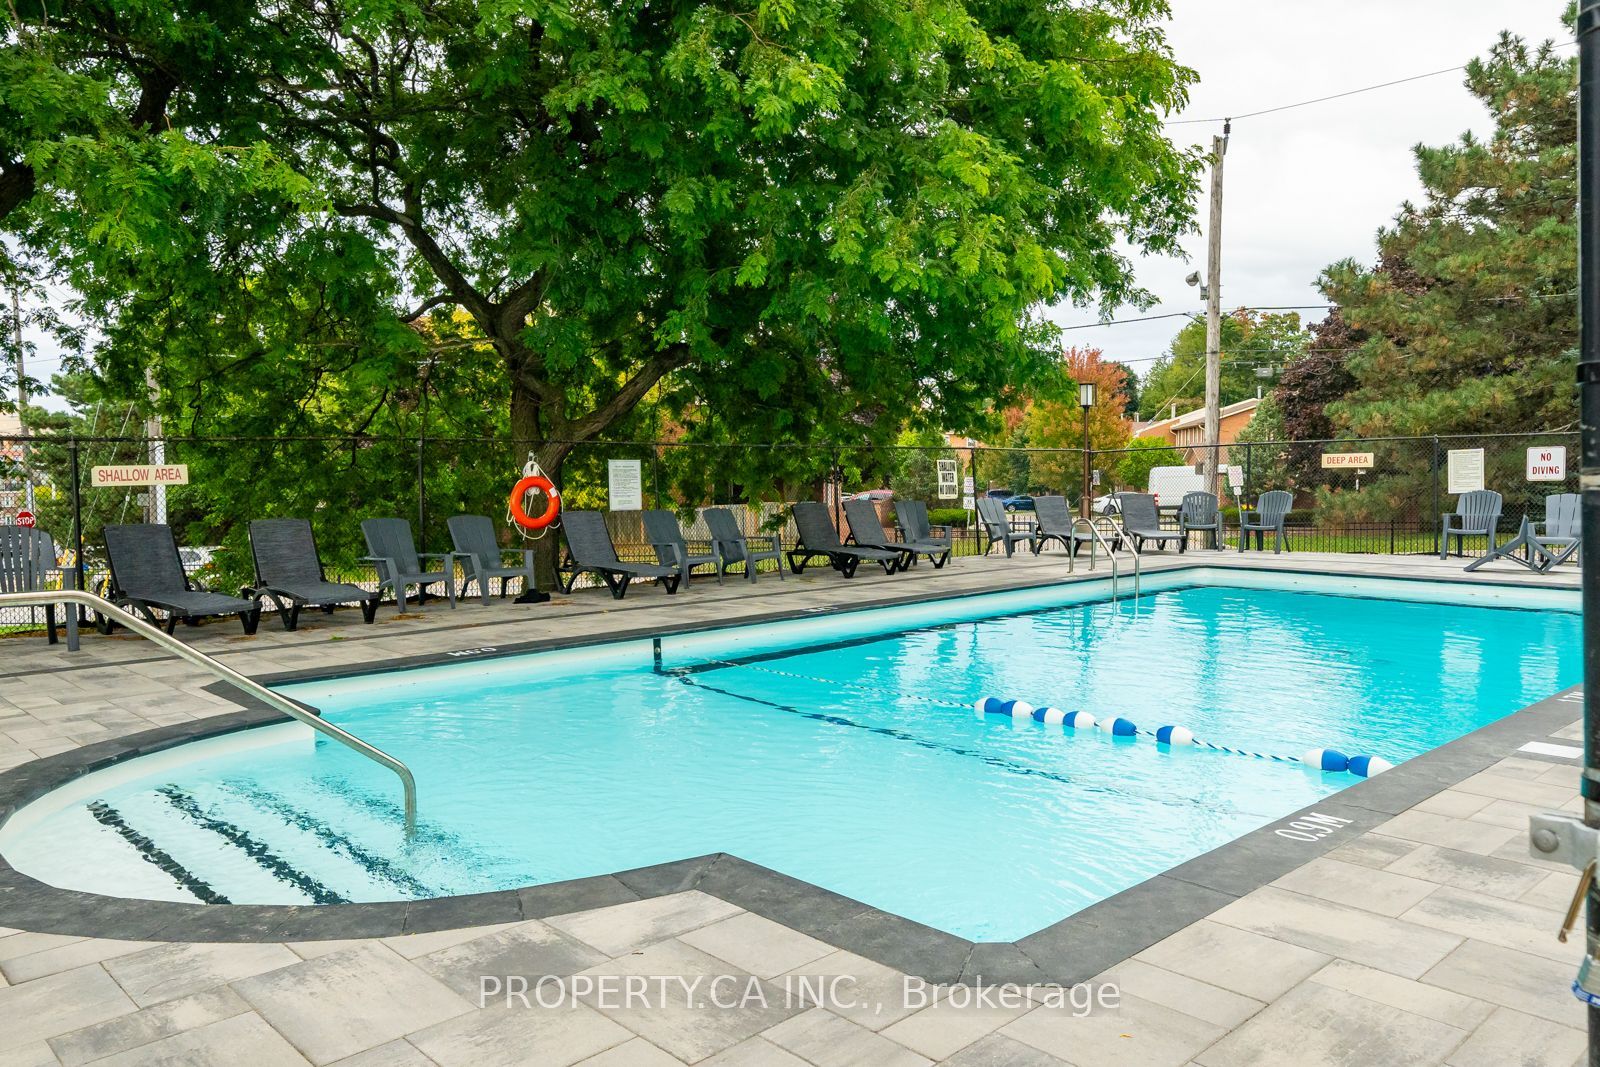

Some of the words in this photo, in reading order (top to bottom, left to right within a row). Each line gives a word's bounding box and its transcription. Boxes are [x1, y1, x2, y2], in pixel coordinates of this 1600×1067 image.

[1326, 456, 1345, 464] DEEP
[1348, 456, 1368, 464] AREA
[1540, 453, 1552, 461] NO
[938, 461, 956, 472] SHALLOW
[1532, 466, 1560, 475] DIVING
[98, 468, 149, 482] SHALLOW
[154, 467, 182, 480] AREA
[941, 472, 955, 482] WATER
[939, 484, 945, 495] NO
[945, 484, 957, 495] DIVING
[17, 516, 35, 526] STOP
[1274, 811, 1354, 842] 0.9M
